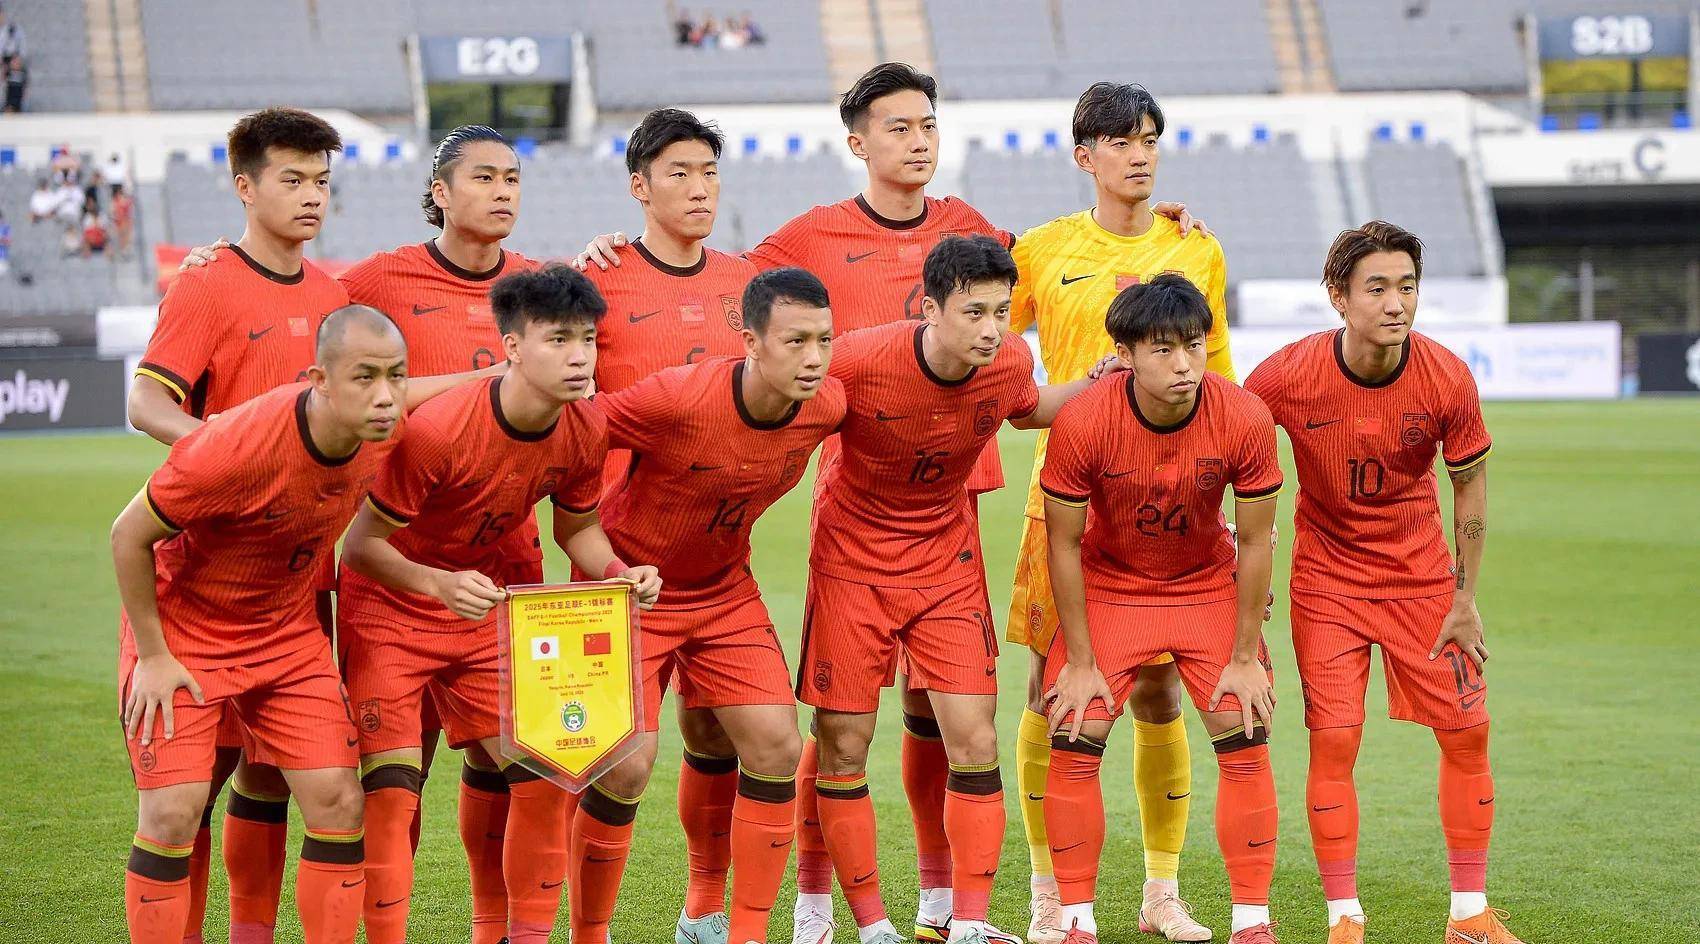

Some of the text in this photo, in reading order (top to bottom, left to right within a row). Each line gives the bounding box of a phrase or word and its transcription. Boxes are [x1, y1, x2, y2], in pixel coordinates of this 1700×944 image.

[1571, 15, 1654, 55] S2B
[0, 369, 70, 424] play
[909, 450, 950, 484] 16
[1348, 457, 1383, 499] 10
[469, 511, 514, 547] 15
[706, 499, 750, 534] 14
[1136, 503, 1188, 537] 24
